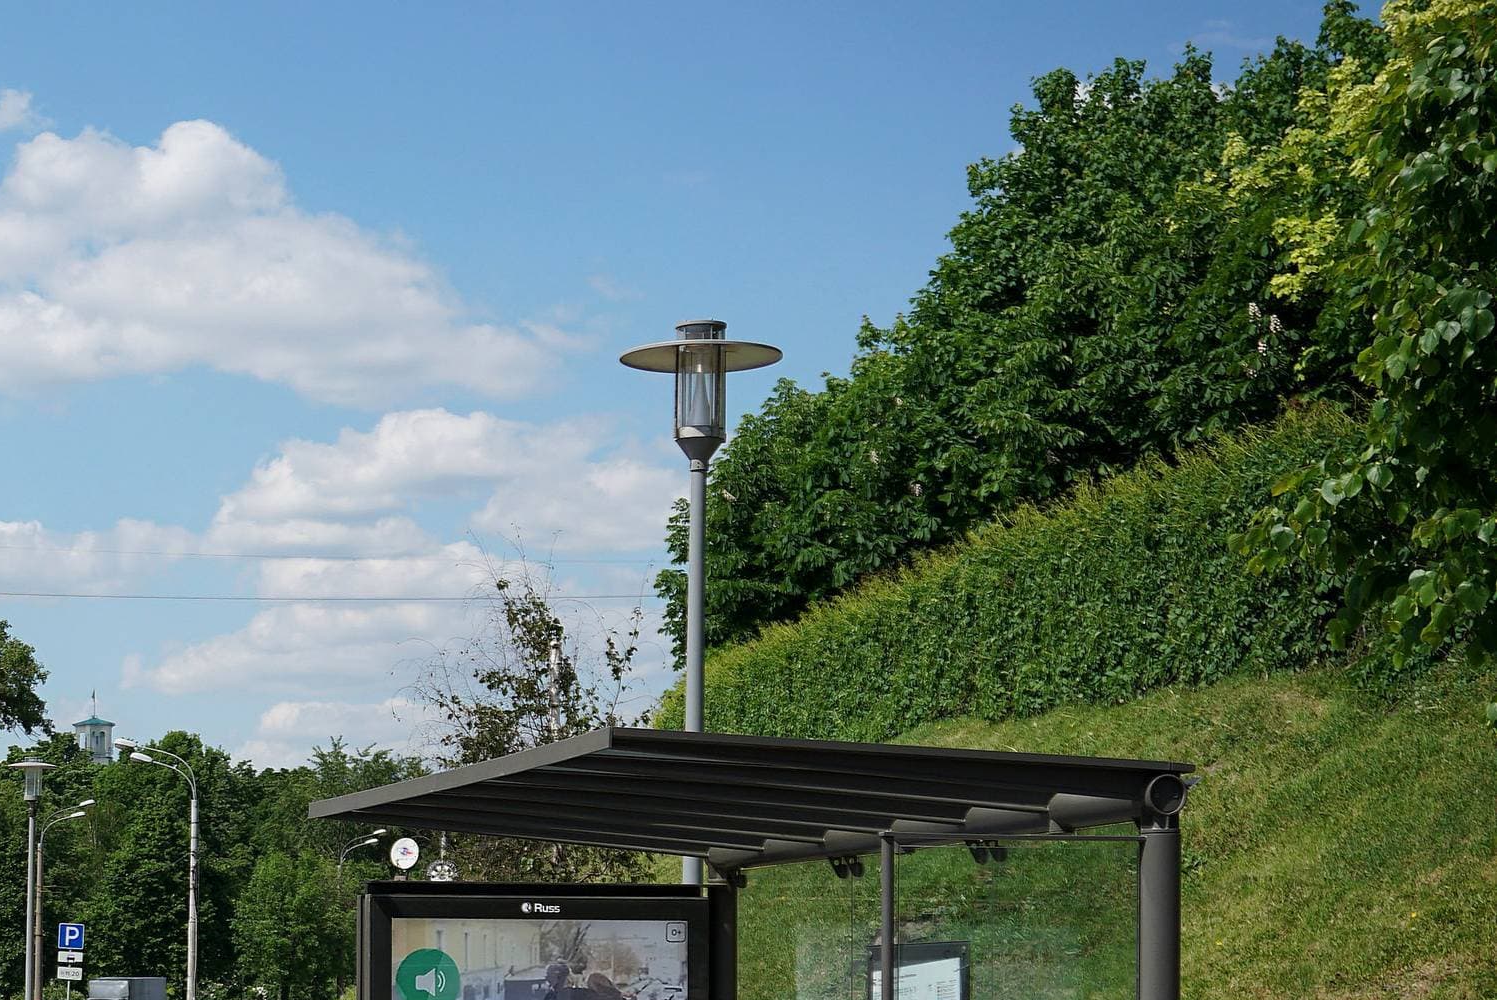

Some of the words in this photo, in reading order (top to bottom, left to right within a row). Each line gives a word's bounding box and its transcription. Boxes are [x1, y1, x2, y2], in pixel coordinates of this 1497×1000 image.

[534, 903, 561, 913] Russ
[65, 926, 80, 946] P
[671, 928, 682, 937] 0+
